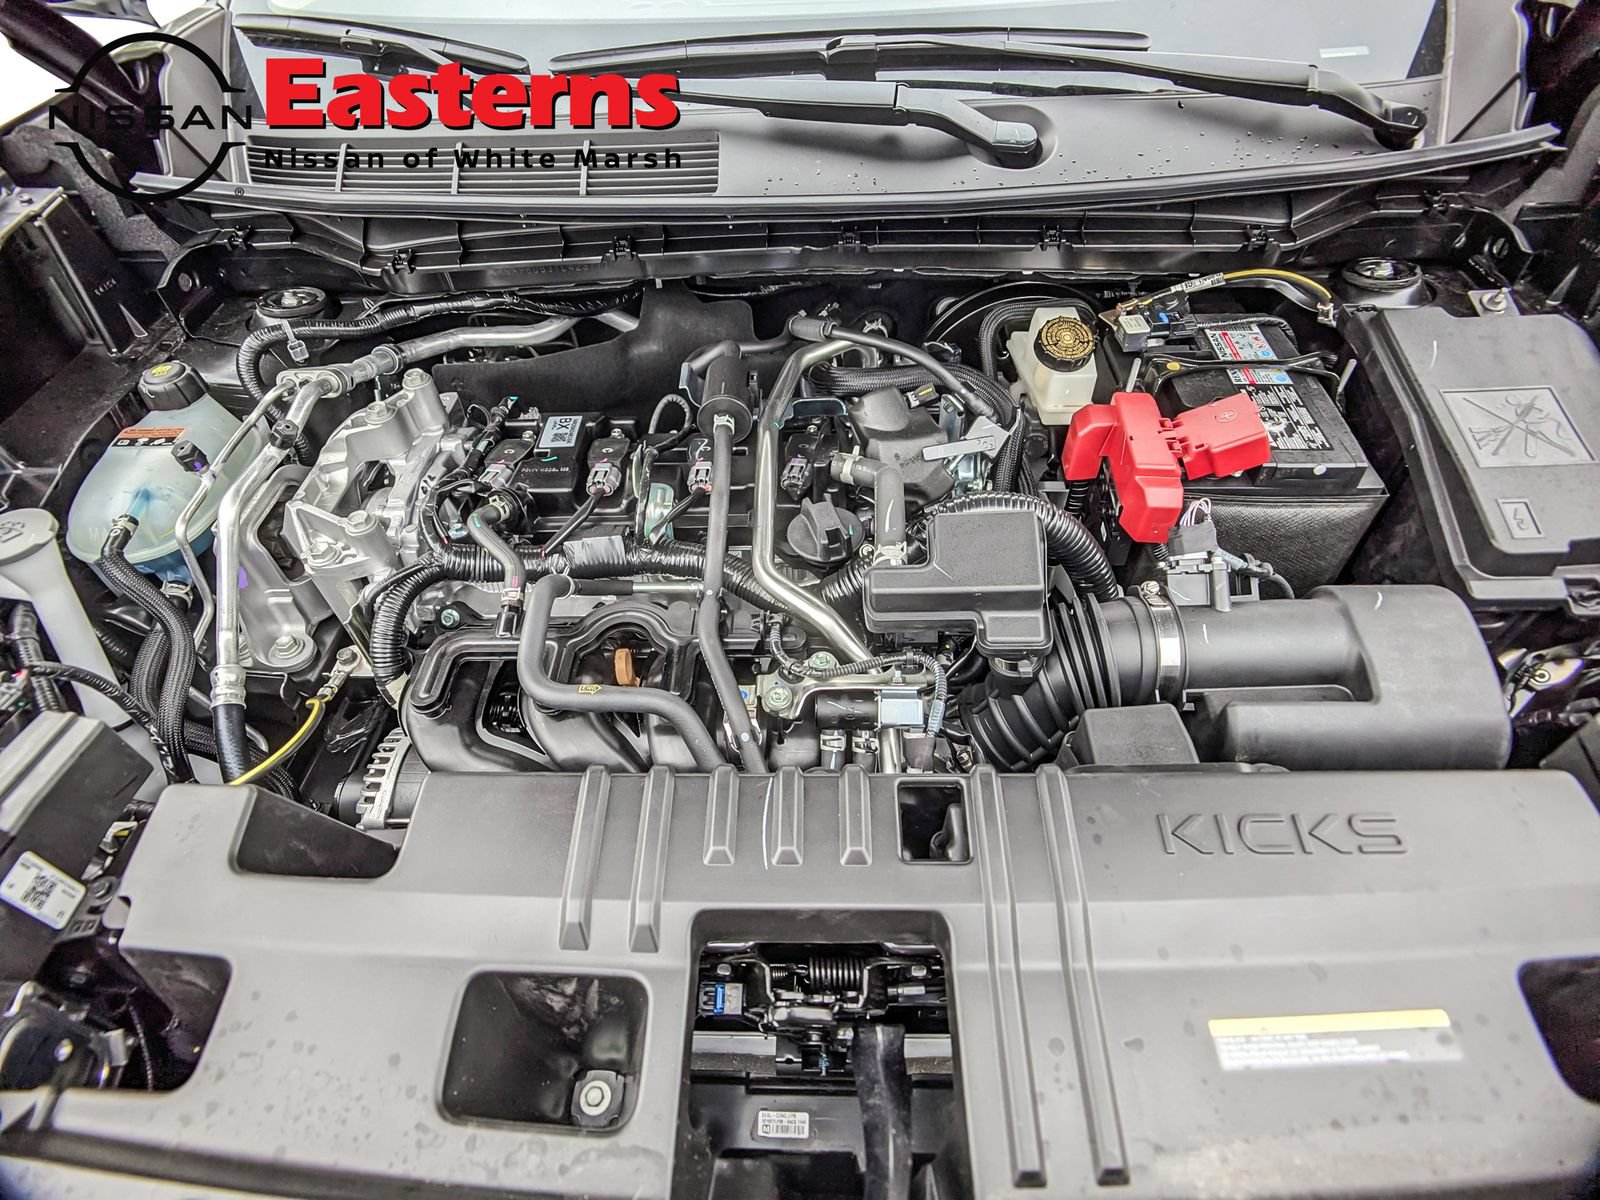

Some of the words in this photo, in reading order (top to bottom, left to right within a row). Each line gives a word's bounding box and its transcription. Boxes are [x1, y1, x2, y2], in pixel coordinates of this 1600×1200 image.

[1210, 333, 1229, 358] NISSAN
[556, 417, 572, 430] BX
[1156, 813, 1407, 855] KICKS
